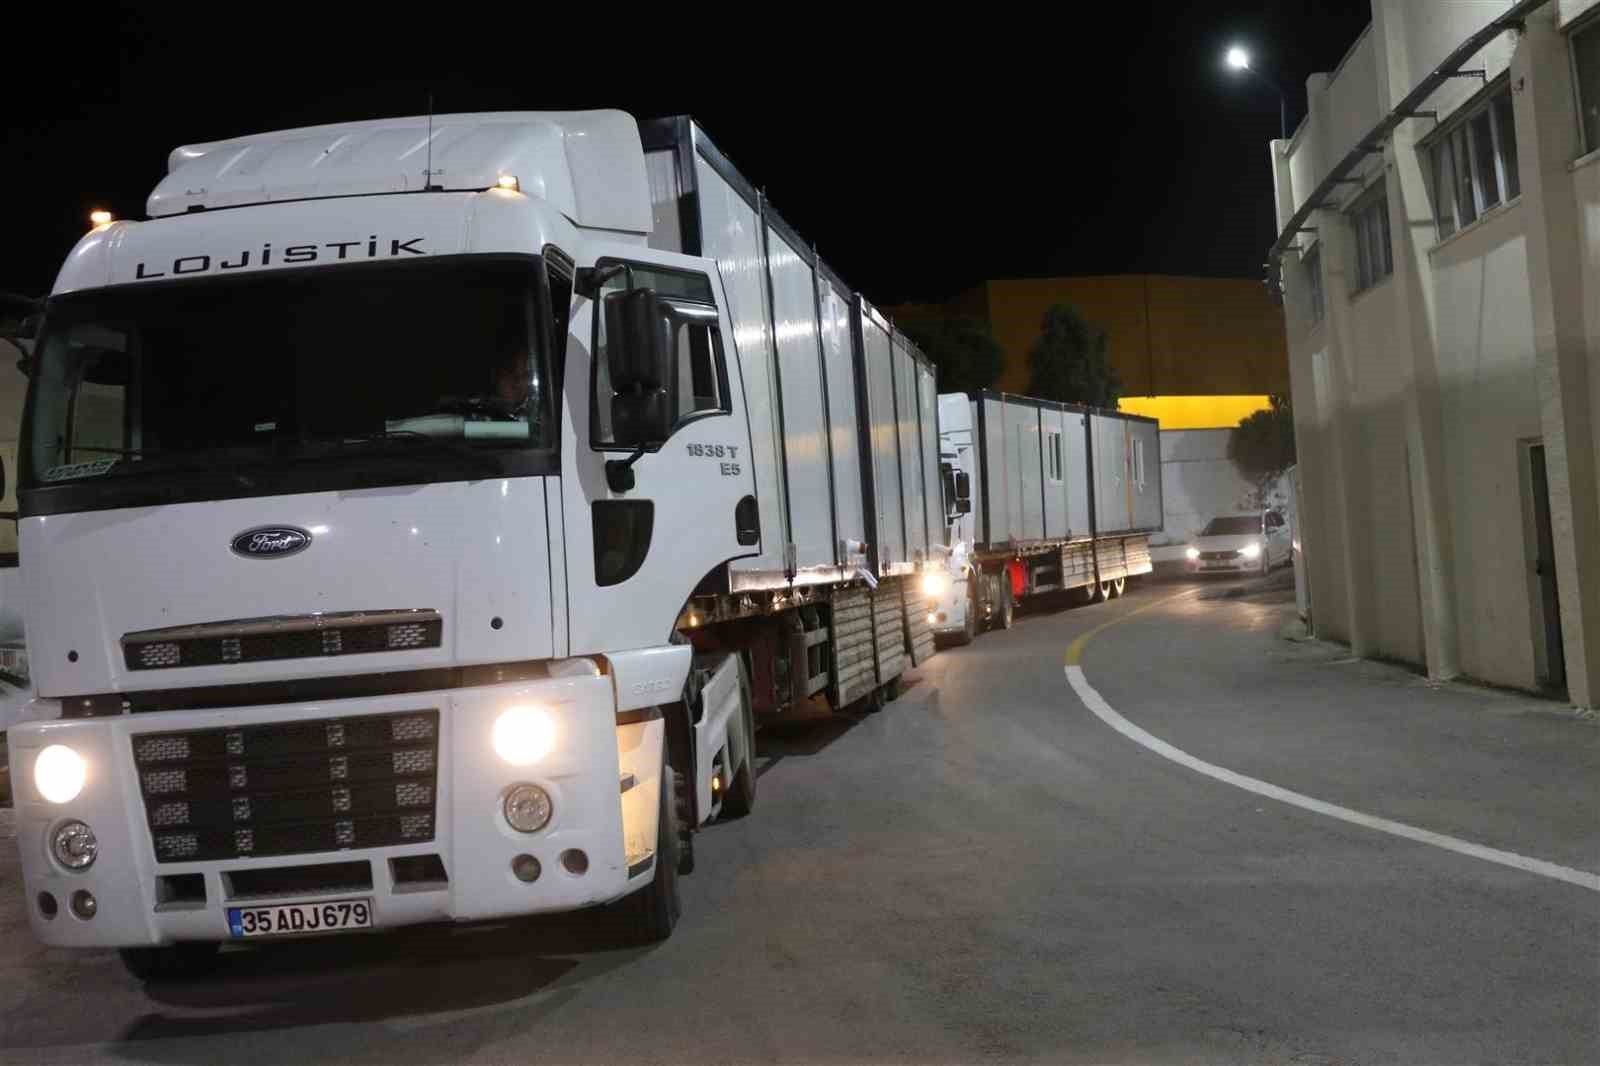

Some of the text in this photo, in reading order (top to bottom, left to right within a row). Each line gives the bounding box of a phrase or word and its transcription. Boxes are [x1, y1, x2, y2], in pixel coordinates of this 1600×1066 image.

[686, 443, 738, 459] 1838 T
[720, 462, 741, 476] E5
[249, 532, 296, 552] Ford
[242, 910, 271, 933] 35
